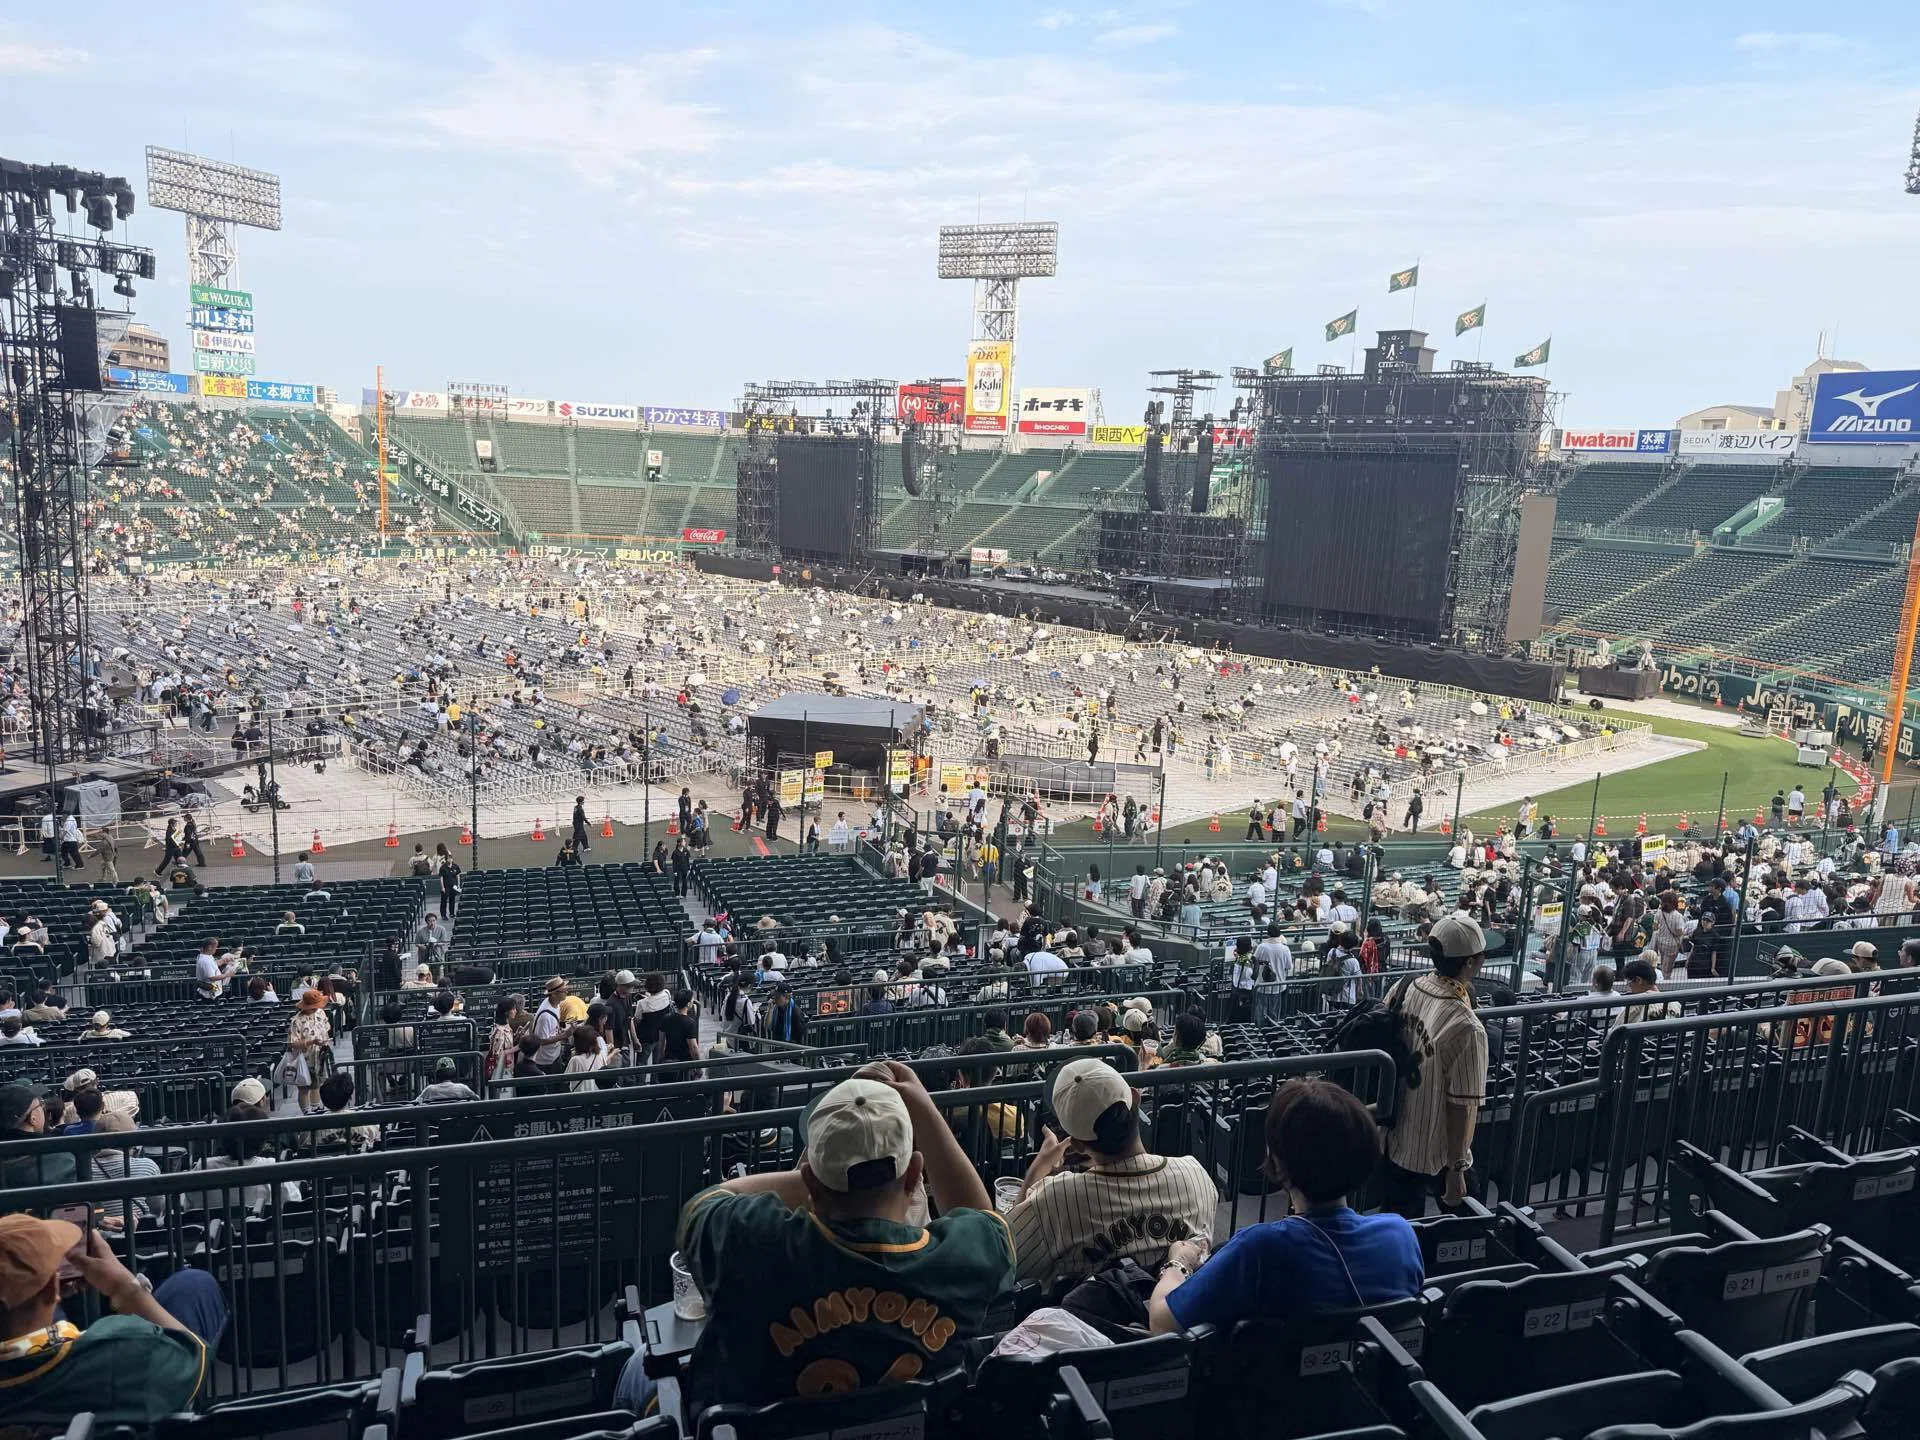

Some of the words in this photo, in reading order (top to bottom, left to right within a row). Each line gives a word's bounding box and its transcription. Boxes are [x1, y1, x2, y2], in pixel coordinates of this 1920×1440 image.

[209, 291, 250, 308] WAZUKA
[195, 309, 252, 329] 川上塗料
[199, 353, 252, 373] 日新火災
[974, 378, 1002, 392] Asahi
[576, 405, 634, 419] SUZUKI
[1024, 398, 1084, 412] ホーチキ
[649, 408, 720, 427] わかさ生活
[1826, 415, 1911, 432] MIZUNO
[1565, 432, 1635, 449] Iwatani
[1641, 432, 1666, 445] 水素
[1849, 711, 1914, 757] 小野品
[513, 1112, 634, 1138] お願い・禁止事項
[1451, 1246, 1464, 1256] 21
[1741, 1277, 1755, 1290] 21
[769, 1286, 957, 1357] AIMYONS
[1544, 1312, 1560, 1327] 22
